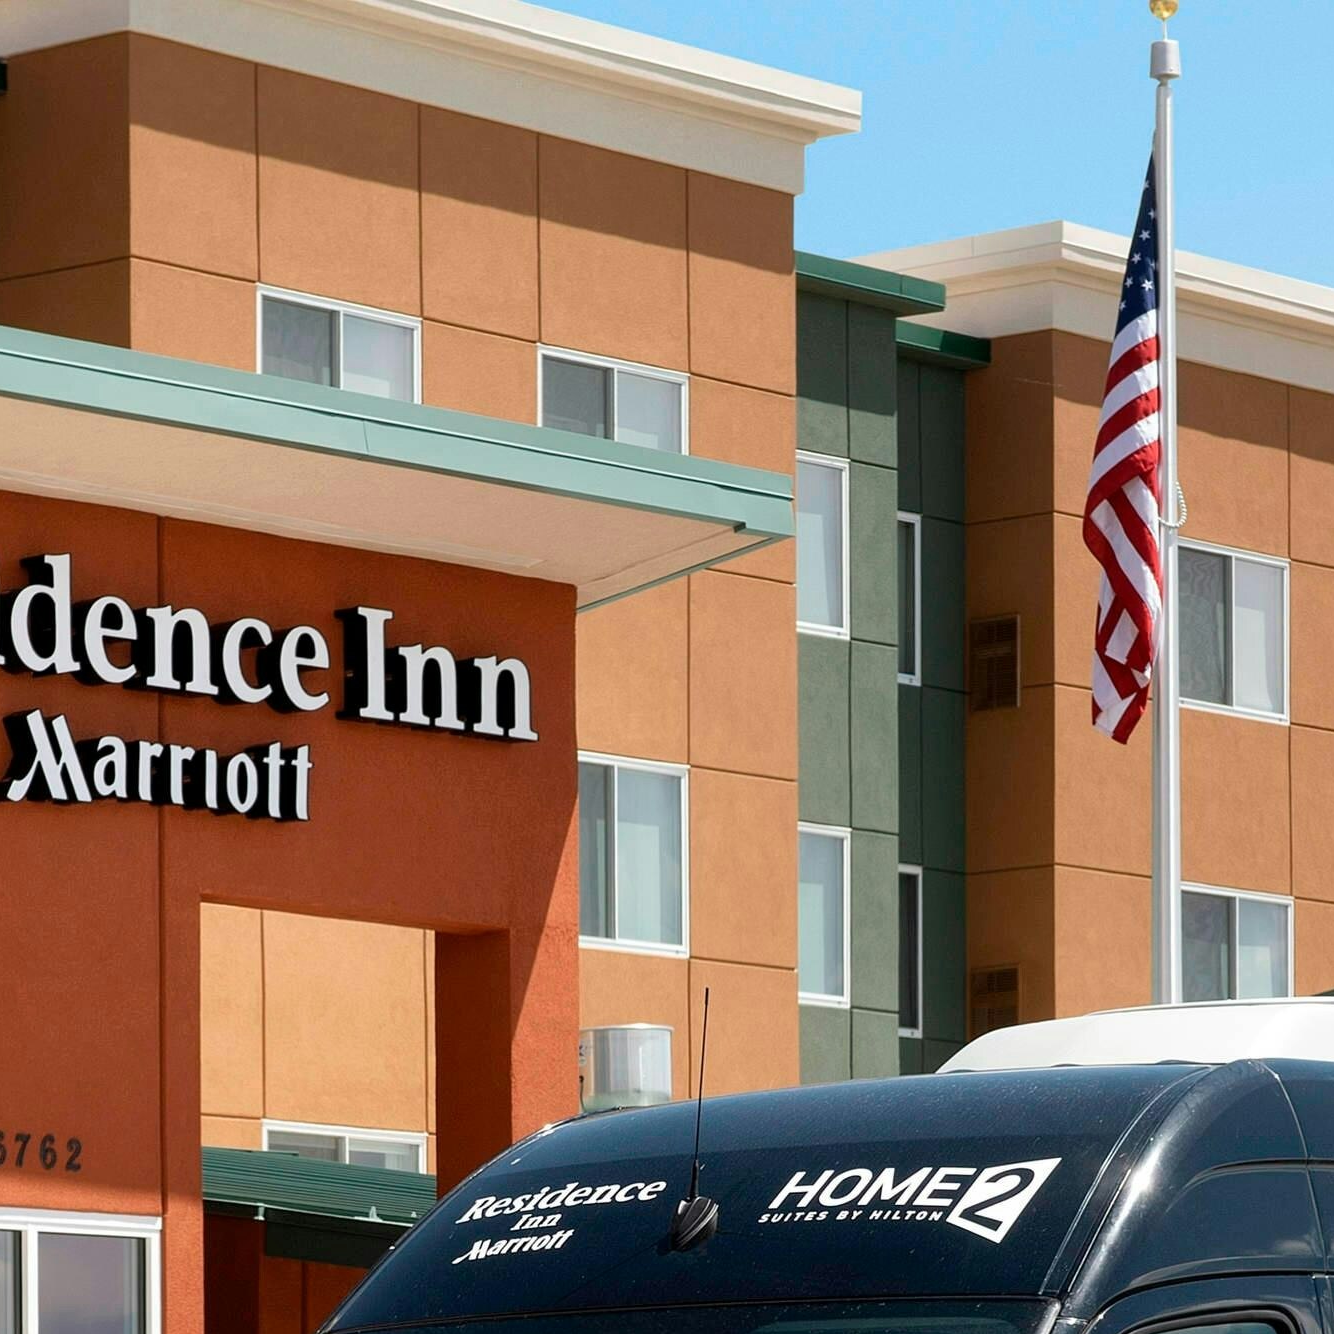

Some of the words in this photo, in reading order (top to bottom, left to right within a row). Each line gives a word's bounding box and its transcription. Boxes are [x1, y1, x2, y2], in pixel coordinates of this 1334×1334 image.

[357, 605, 539, 742] Inn
[6, 708, 314, 821] Marriott
[455, 1181, 667, 1225] Residence
[509, 1213, 563, 1231] Inn
[757, 1210, 829, 1224] SUITES
[835, 1210, 864, 1221] BY
[868, 1210, 944, 1222] HILTON
[451, 1228, 575, 1265] Marriott
